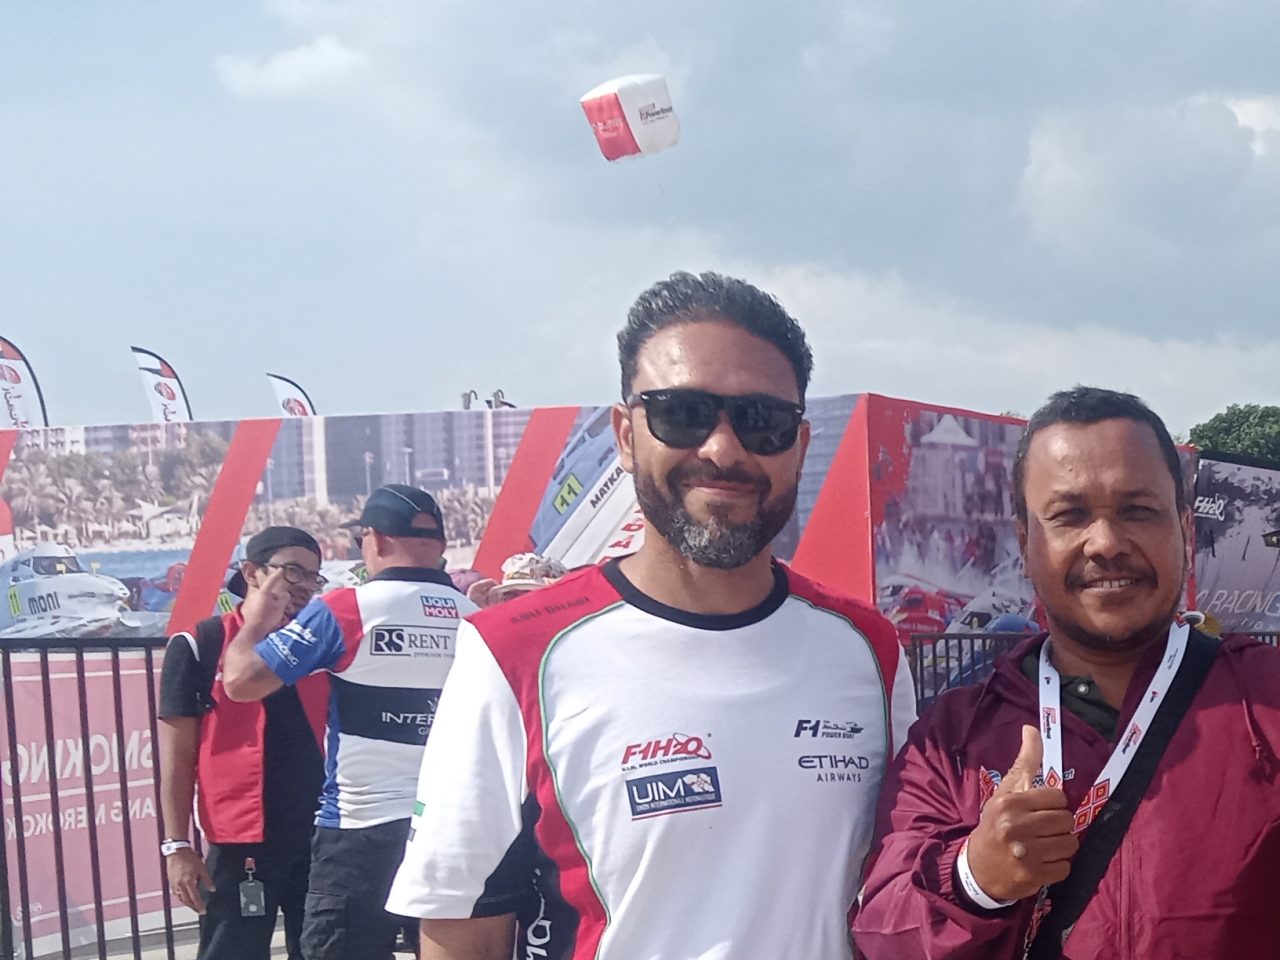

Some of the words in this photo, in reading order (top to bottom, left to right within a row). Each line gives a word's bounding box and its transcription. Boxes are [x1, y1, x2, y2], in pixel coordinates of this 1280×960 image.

[422, 596, 456, 607] LIQUI
[425, 607, 459, 618] MOLY
[375, 629, 405, 653] RS
[408, 632, 450, 650] RENT
[798, 755, 870, 769] ETIHAD
[817, 772, 862, 782] AIRWAYS
[632, 778, 685, 804] UIM
